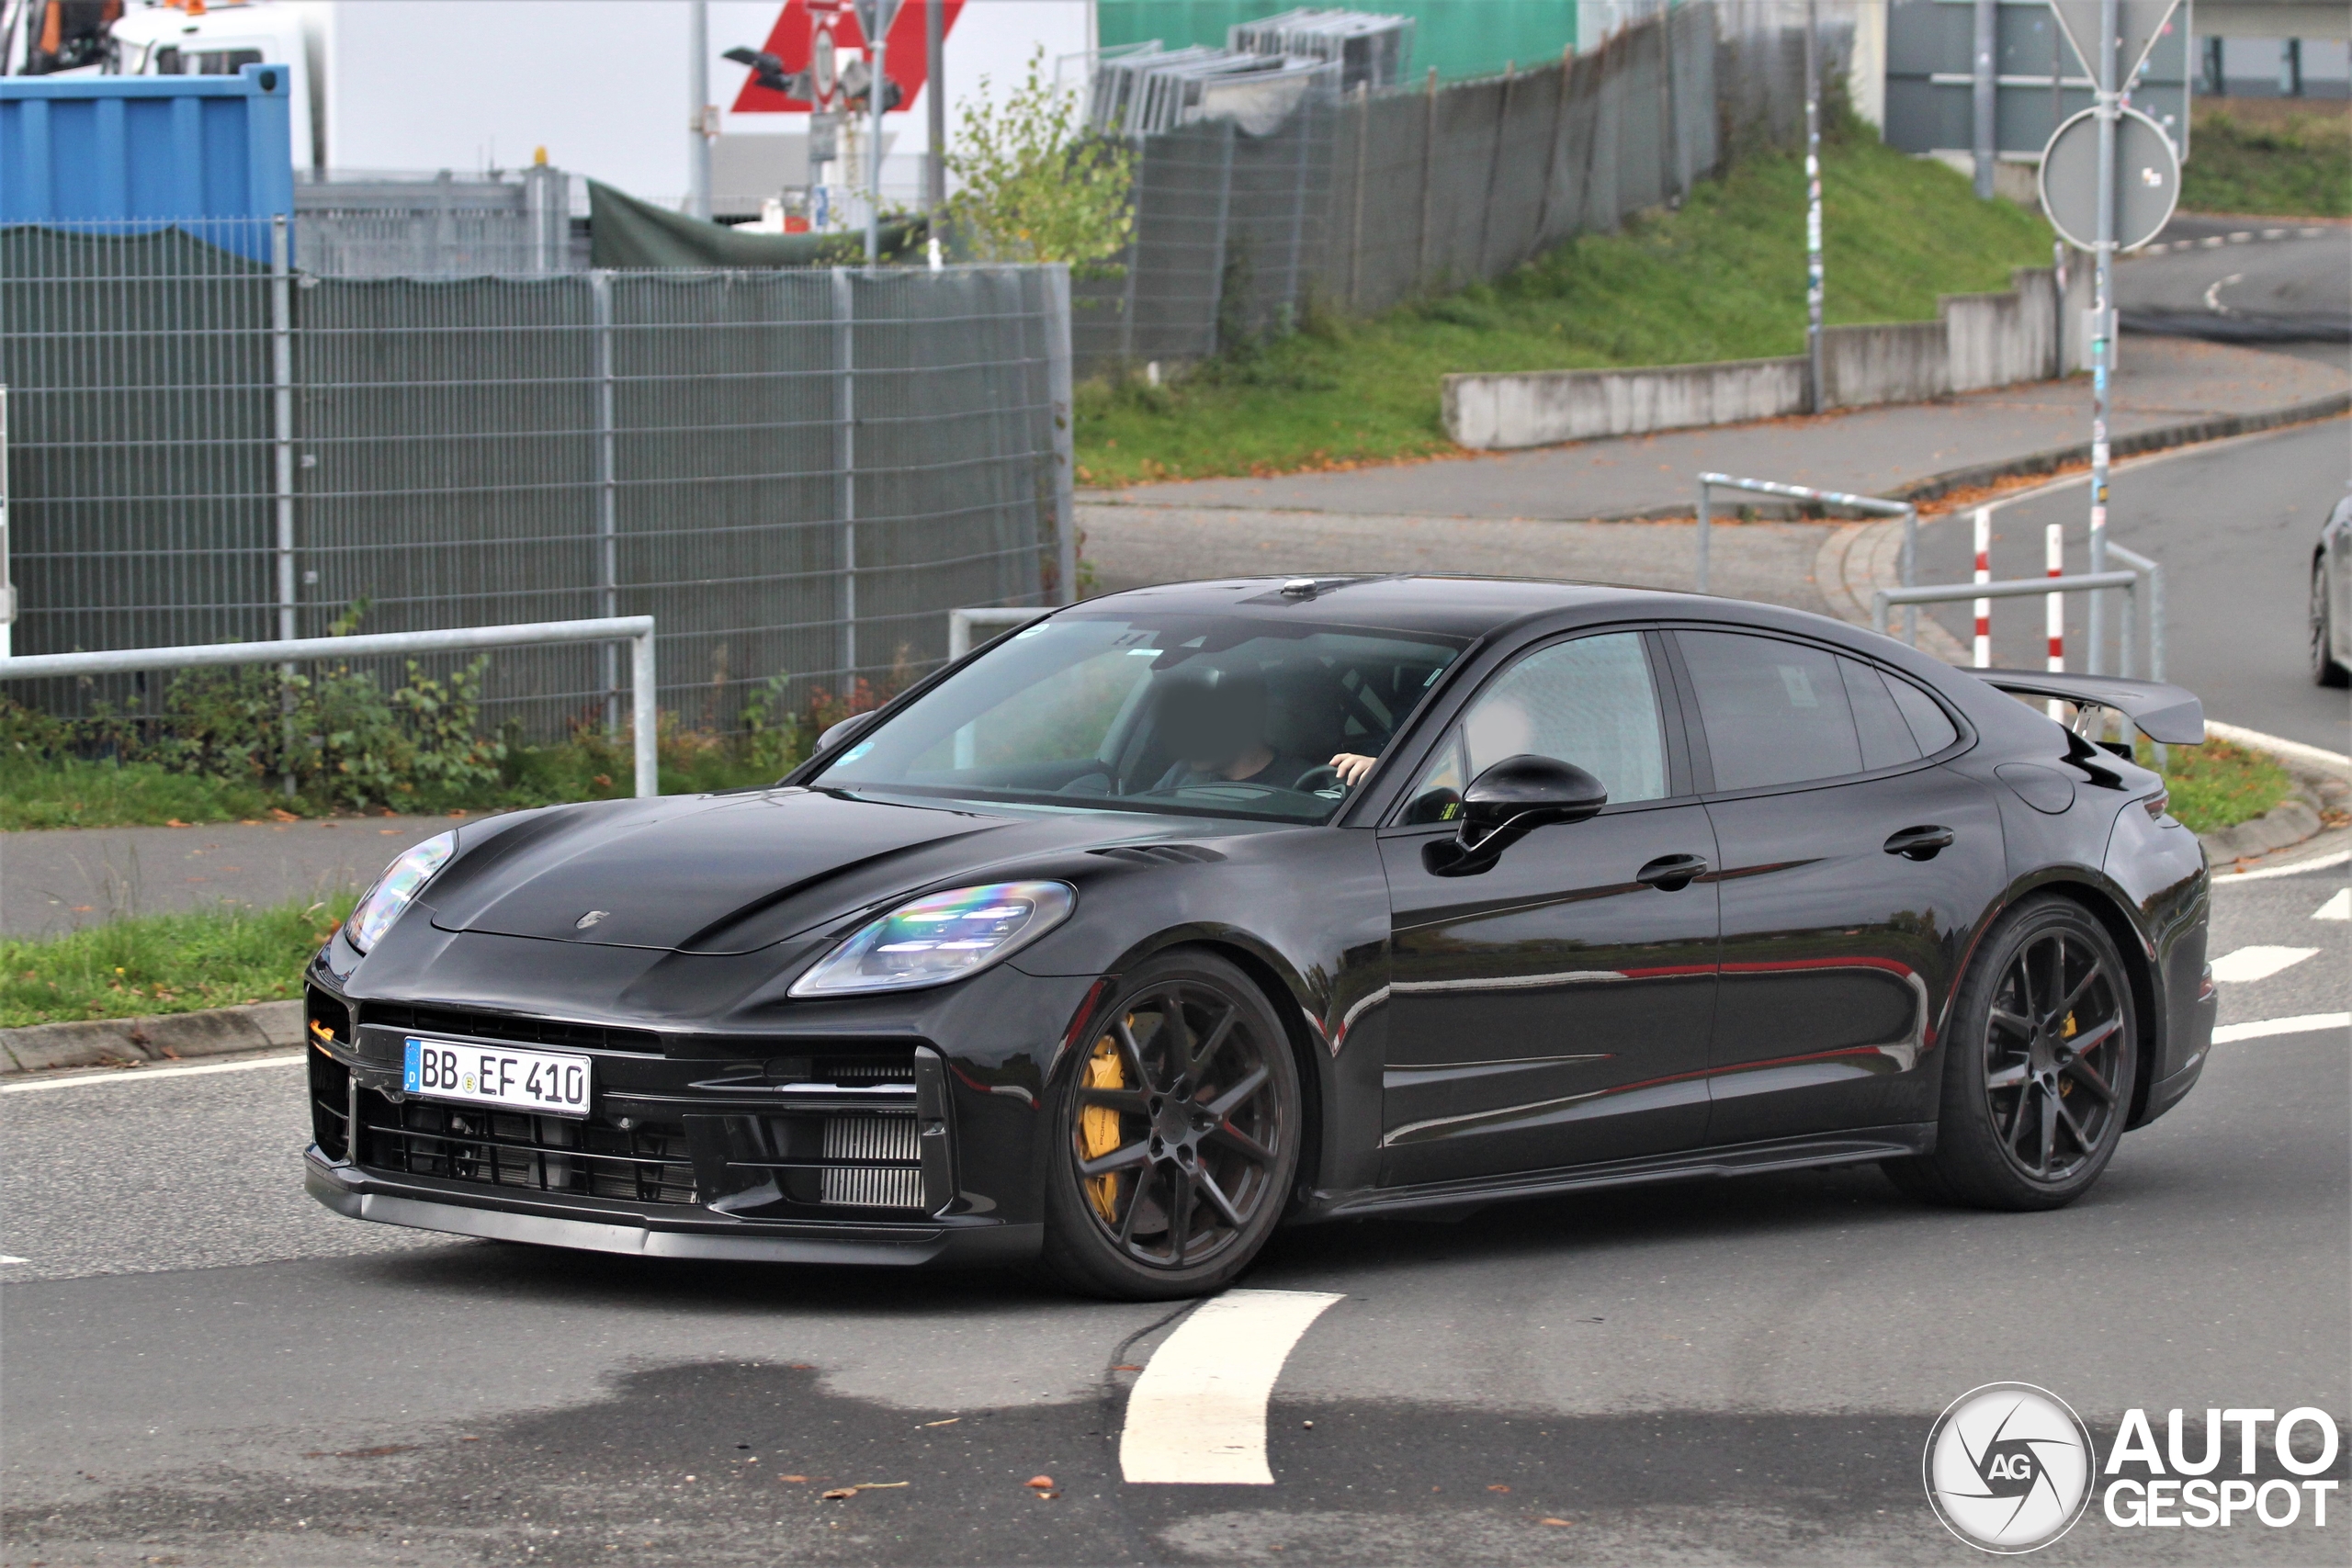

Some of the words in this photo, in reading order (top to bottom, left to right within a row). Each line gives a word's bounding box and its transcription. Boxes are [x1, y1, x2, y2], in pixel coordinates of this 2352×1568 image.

[409, 1071, 416, 1083] D
[422, 1048, 458, 1090] BB
[480, 1055, 518, 1096] EF
[526, 1061, 583, 1104] 410
